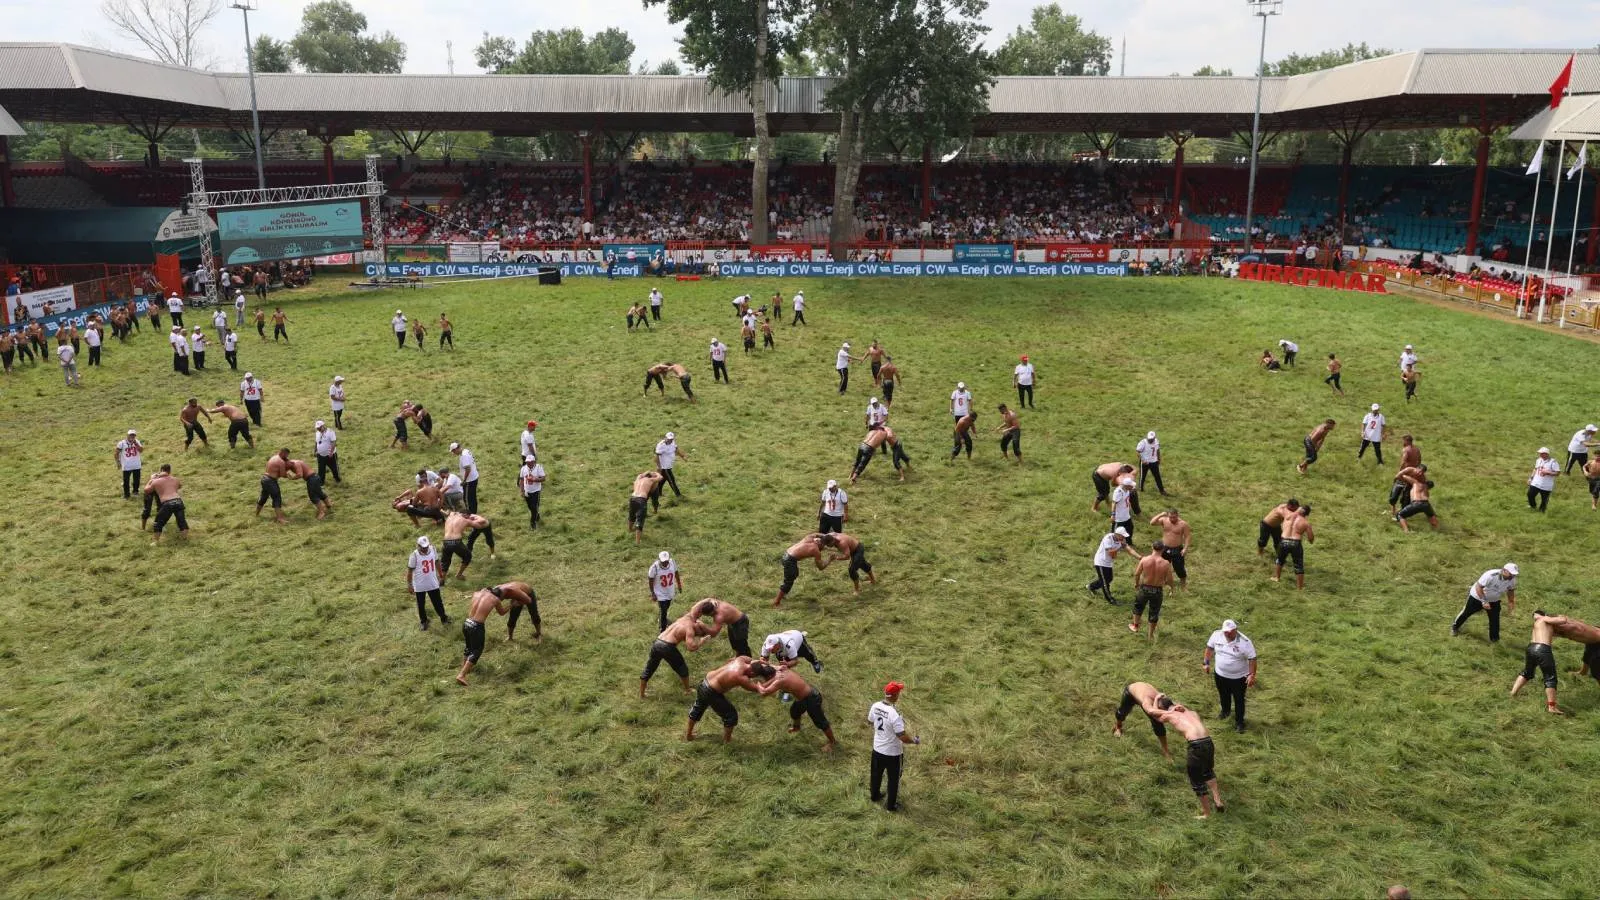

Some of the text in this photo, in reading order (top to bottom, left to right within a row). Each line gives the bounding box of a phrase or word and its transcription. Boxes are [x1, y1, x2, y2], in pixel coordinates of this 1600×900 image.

[366, 264, 386, 275] CW
[435, 264, 500, 277] CW Enerji
[505, 265, 527, 275] CW
[574, 264, 639, 276] CW Enerji
[721, 264, 785, 276] CW Enerji
[790, 264, 853, 276] CW Enerji
[858, 264, 921, 276] CW Enerji
[926, 264, 989, 276] CW Enerji
[994, 264, 1056, 276] CW Enerji
[1061, 264, 1125, 276] CW Enerji
[422, 559, 434, 573] 31
[660, 573, 673, 587] 32
[877, 716, 884, 731] 2
